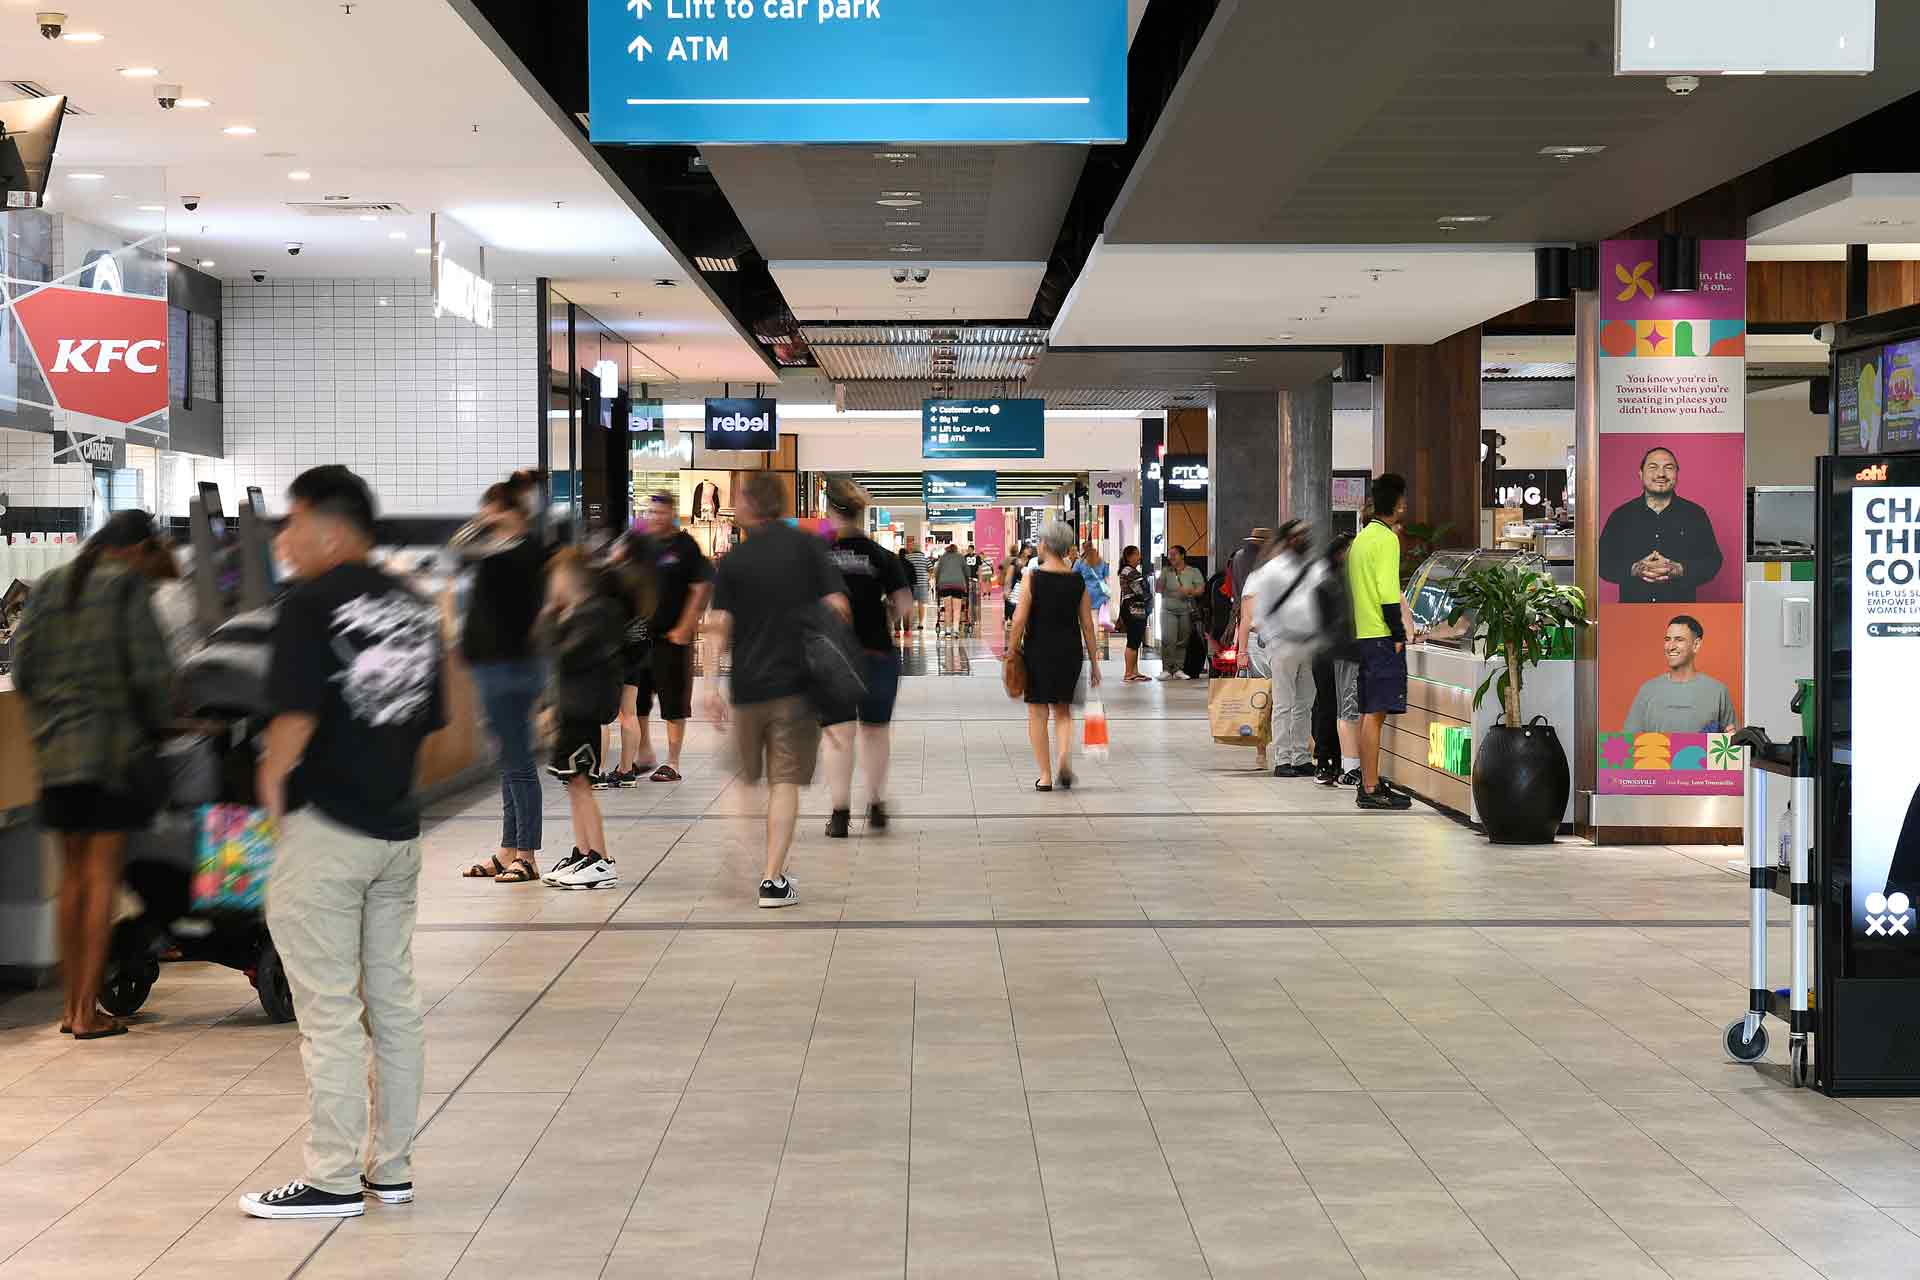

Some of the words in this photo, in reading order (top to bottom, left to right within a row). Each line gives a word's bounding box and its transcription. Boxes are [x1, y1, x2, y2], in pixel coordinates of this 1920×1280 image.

[667, 0, 716, 19] Lift
[725, 0, 754, 19] to
[763, 0, 808, 19] car
[818, 0, 881, 24] park
[667, 36, 728, 61] ATM
[1714, 271, 1732, 281] the
[50, 339, 161, 374] KFC
[1627, 375, 1645, 383] You
[1647, 375, 1674, 383] know
[1676, 375, 1705, 385] you're
[1708, 375, 1718, 383] in
[1616, 385, 1668, 393] Townsville
[1670, 385, 1697, 393] when
[1699, 385, 1729, 395] you're
[1617, 395, 1662, 405] sweating
[1664, 395, 1674, 403] in
[1676, 395, 1707, 405] places
[1709, 397, 1727, 406] you
[1620, 406, 1647, 414] didn't
[1650, 406, 1677, 414] know
[1679, 407, 1697, 416] you
[712, 412, 769, 432] rebel
[84, 442, 113, 461] CARVERY
[1097, 480, 1122, 489] donut
[1495, 487, 1541, 505] ING
[1866, 559, 1920, 585] CO
[1867, 590, 1891, 598] HELP
[1894, 590, 1907, 598] US
[1867, 598, 1916, 606] EMPOWER
[1867, 606, 1906, 614] WOMEN
